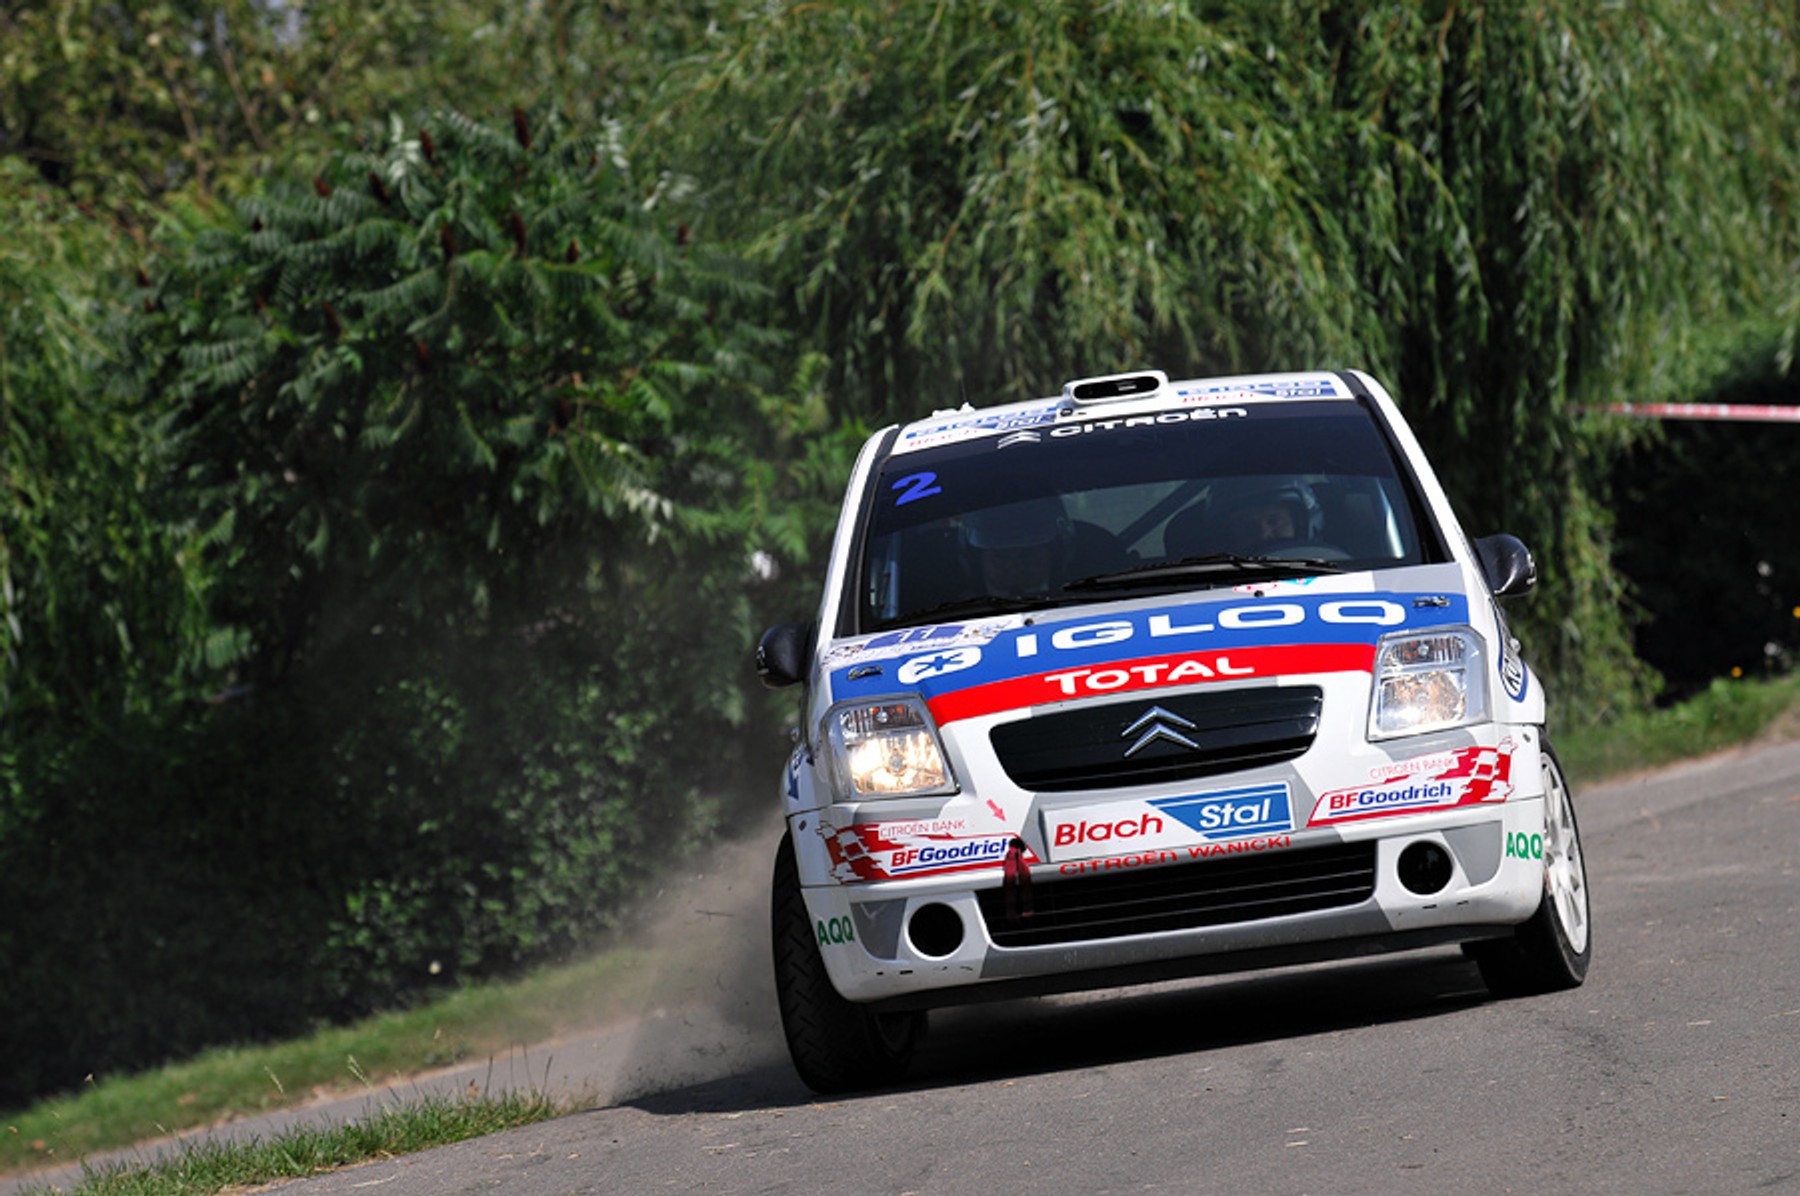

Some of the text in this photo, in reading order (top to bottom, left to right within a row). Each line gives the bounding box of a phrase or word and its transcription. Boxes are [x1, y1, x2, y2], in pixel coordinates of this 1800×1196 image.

[892, 471, 942, 507] 2
[1044, 656, 1255, 695] TOTAL
[1424, 756, 1456, 770] BANK
[1330, 782, 1452, 810] BFGoodrich
[932, 820, 966, 832] BANK
[1053, 797, 1272, 847] Blach Stal
[1187, 835, 1291, 860] WANICKI
[1505, 831, 1543, 860] AQQ
[816, 915, 856, 947] AQQ
